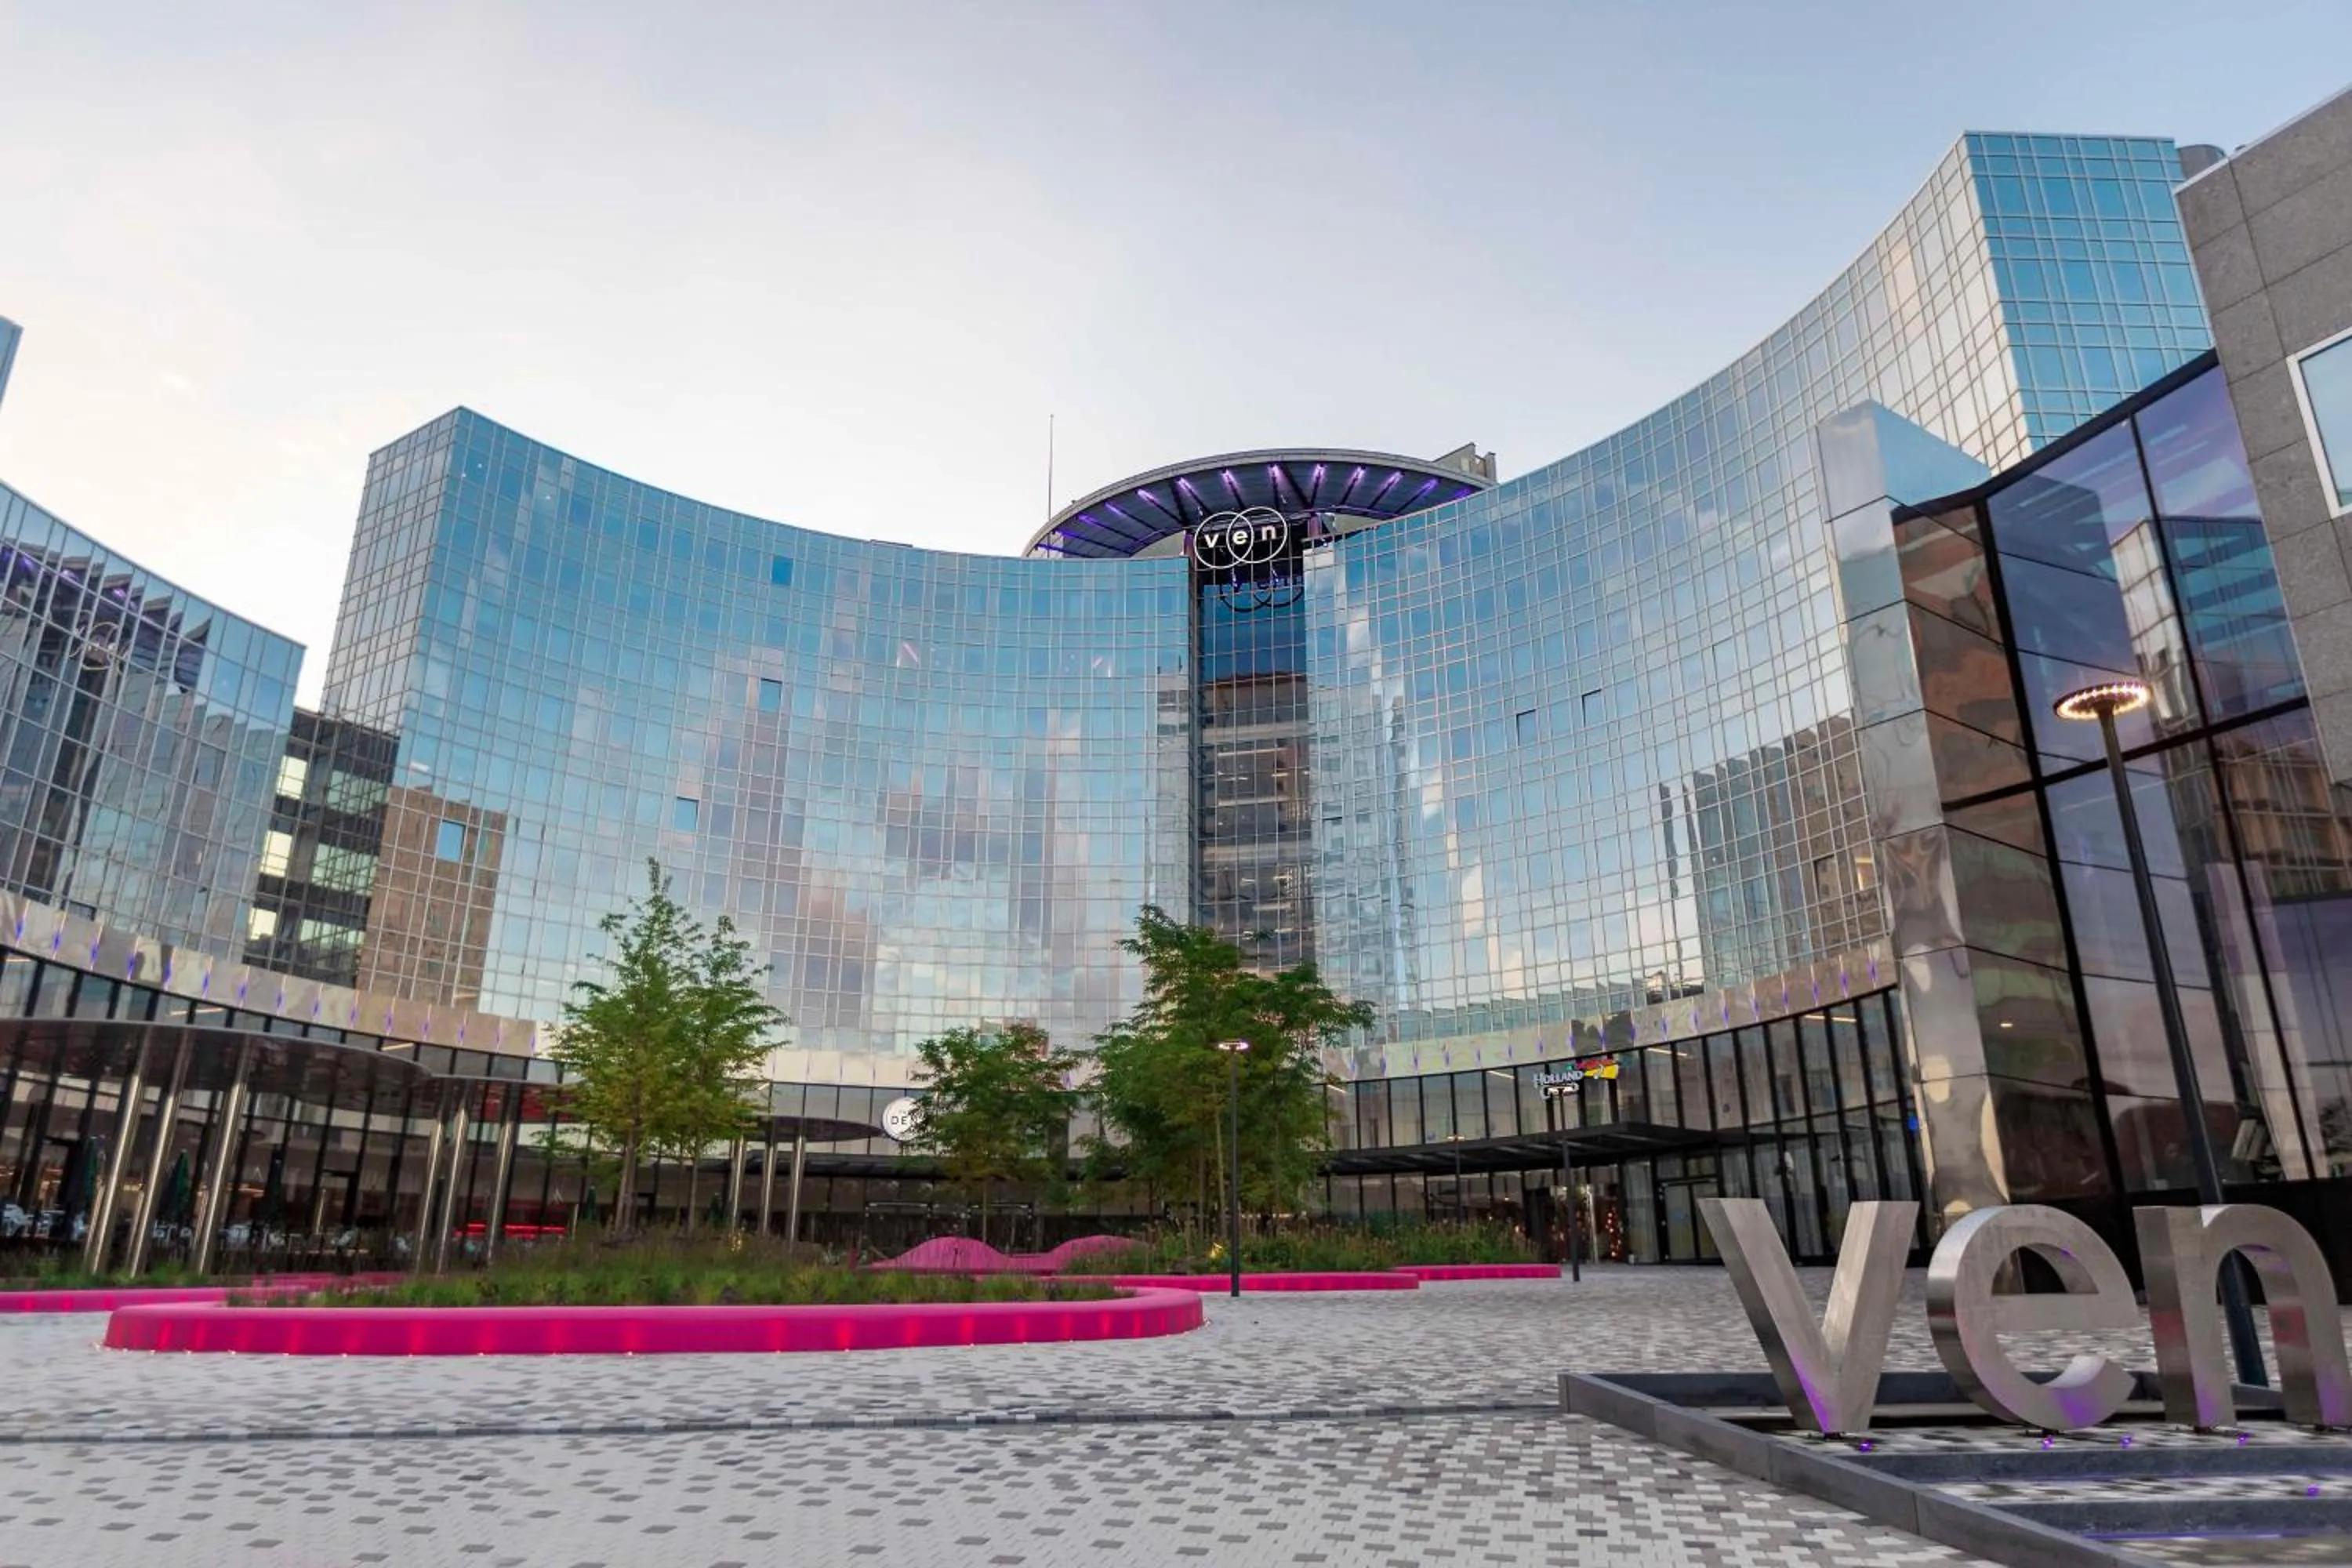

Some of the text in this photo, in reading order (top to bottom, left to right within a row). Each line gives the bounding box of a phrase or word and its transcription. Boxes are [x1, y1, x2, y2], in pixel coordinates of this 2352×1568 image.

[1205, 524, 1277, 548] ven
[1533, 1070, 1584, 1089] HOLLAND
[1697, 1197, 2351, 1433] ven
